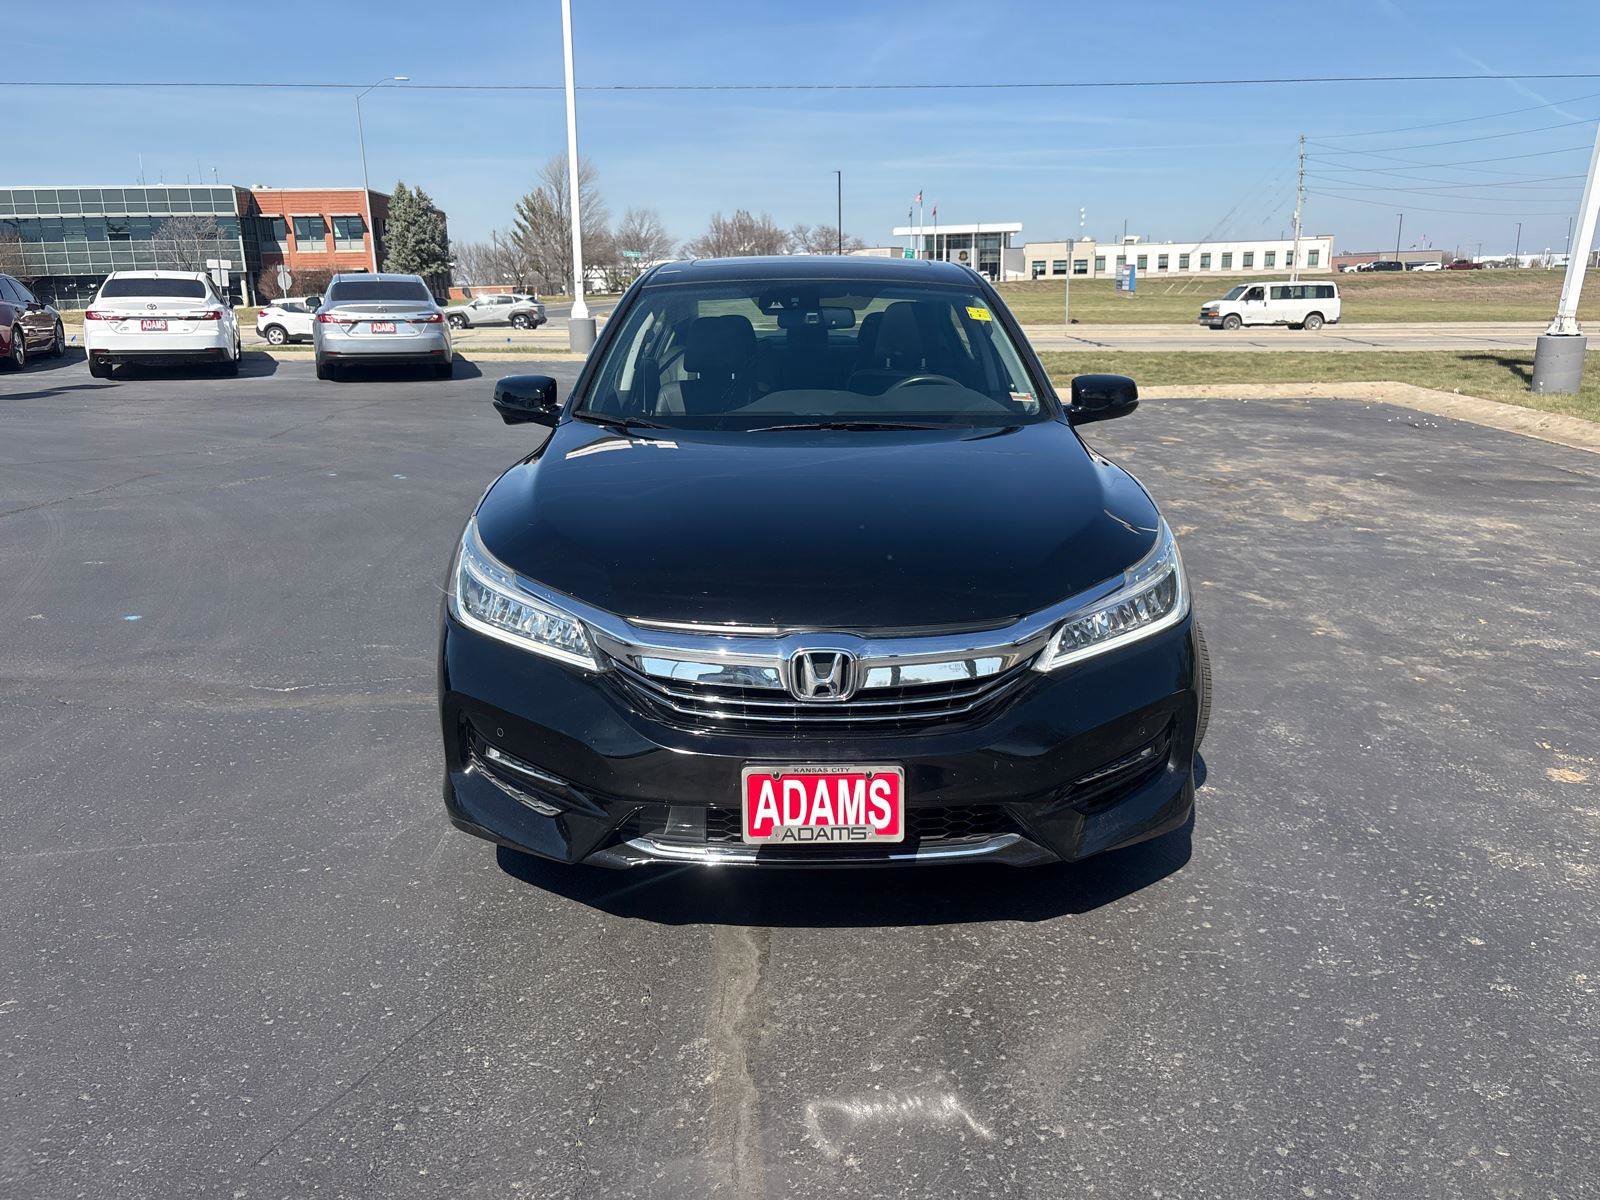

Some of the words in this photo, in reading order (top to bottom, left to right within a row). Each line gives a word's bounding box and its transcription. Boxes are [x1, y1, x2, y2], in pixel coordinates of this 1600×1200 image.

[142, 320, 166, 329] ADAMS
[373, 323, 395, 333] ADAMS
[753, 779, 892, 829] ADAMS
[781, 827, 867, 841] ADAMS
